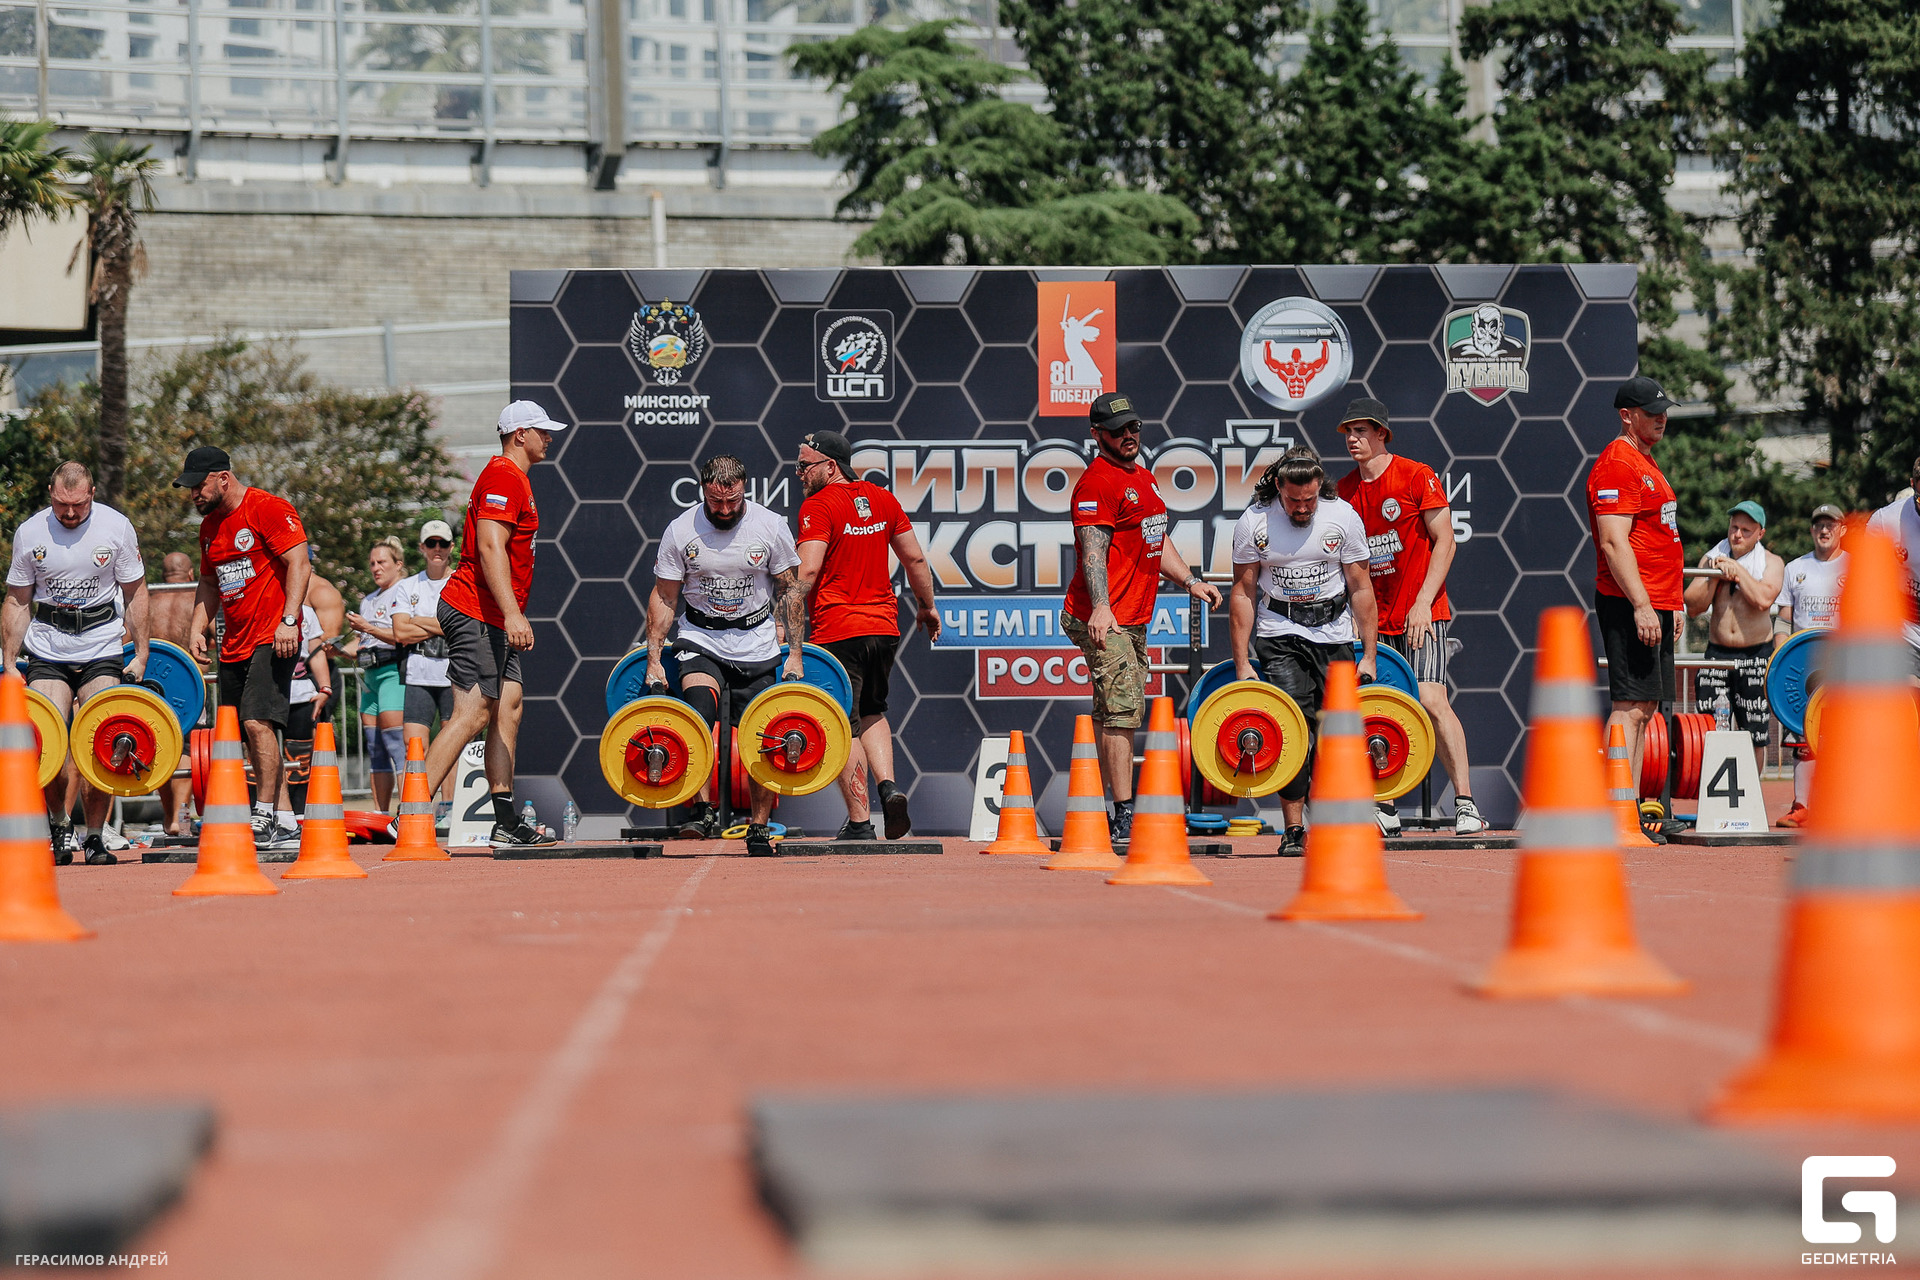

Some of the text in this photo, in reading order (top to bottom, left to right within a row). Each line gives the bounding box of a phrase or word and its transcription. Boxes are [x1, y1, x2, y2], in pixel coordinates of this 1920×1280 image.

[1050, 360, 1077, 385] 80
[1448, 361, 1526, 389] КУБАНЬ
[827, 378, 884, 397] ЦСП
[624, 395, 710, 408] МИНСПОРТ
[634, 411, 700, 425] РОССИИ
[850, 428, 1285, 514] СИЛООЙ
[670, 477, 789, 507] СЧИ
[1368, 529, 1399, 547] ОВОЙ
[1369, 541, 1403, 557] ТРИМ
[1269, 561, 1328, 579] СИЛОВОЙ
[1272, 573, 1330, 589] ЭКСТРИМ
[1284, 587, 1319, 595] ЧЕМПИОНАТ
[944, 609, 1190, 637] ЧЕМПАТ
[987, 656, 1152, 685] РОСС
[1735, 693, 1768, 712] Angels
[1707, 757, 1744, 808] 4
[462, 770, 497, 821] 2
